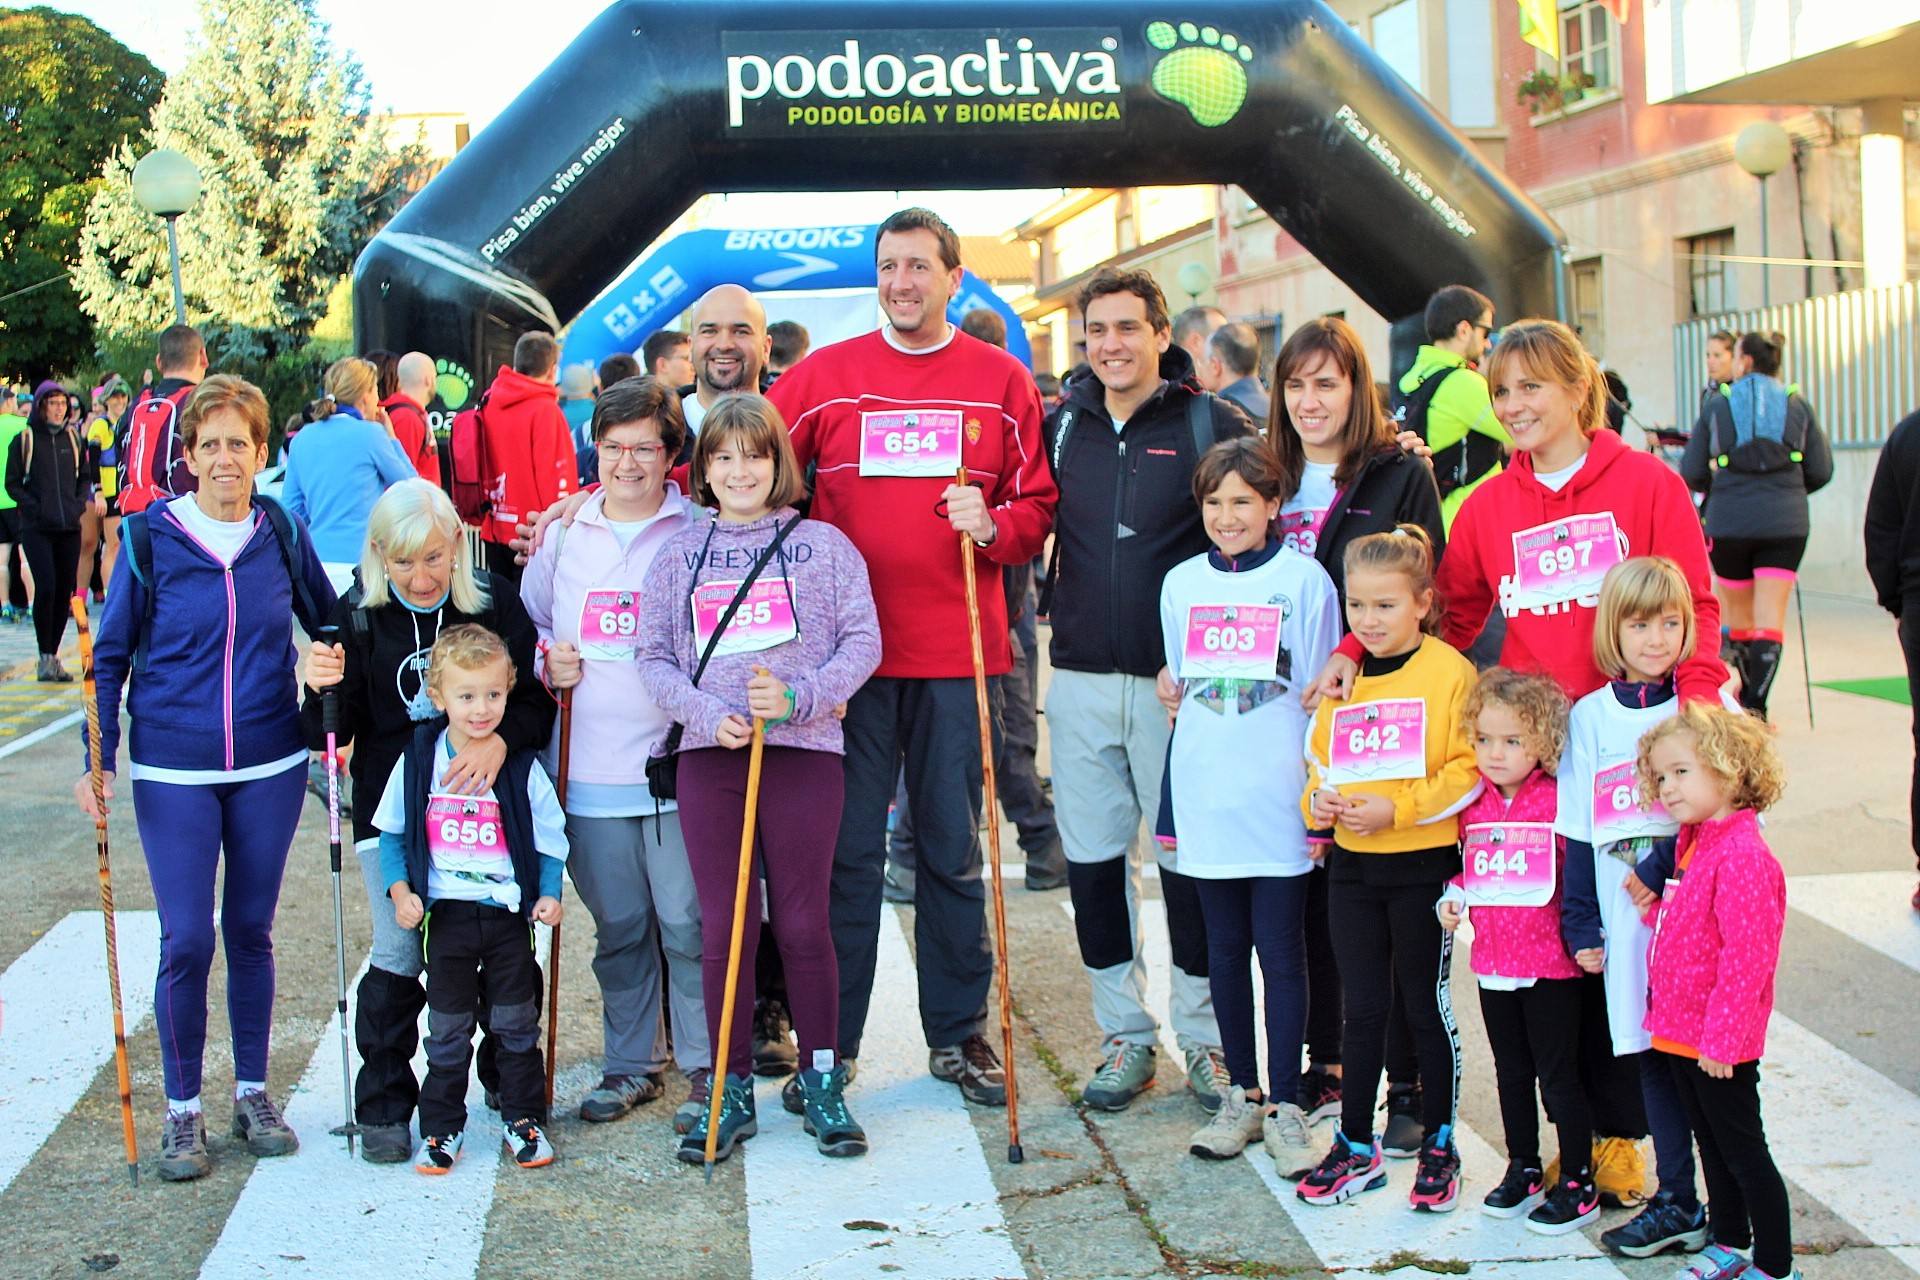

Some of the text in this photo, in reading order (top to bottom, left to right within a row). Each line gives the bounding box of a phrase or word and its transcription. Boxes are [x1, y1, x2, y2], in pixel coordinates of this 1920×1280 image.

[727, 38, 1121, 127] podoactiva
[788, 97, 1121, 125] PODOLOGÍA Y BIOMECÁNICA
[1335, 104, 1477, 238] Pisa bien, vive mejor
[480, 117, 626, 263] Pisa bien, vive mejor
[724, 226, 867, 251] BROOKS
[884, 431, 939, 453] 654
[1538, 540, 1593, 576] 697
[1203, 626, 1256, 652] 603
[1349, 724, 1401, 754] 642
[441, 818, 498, 846] 656
[1474, 849, 1529, 876] 644
